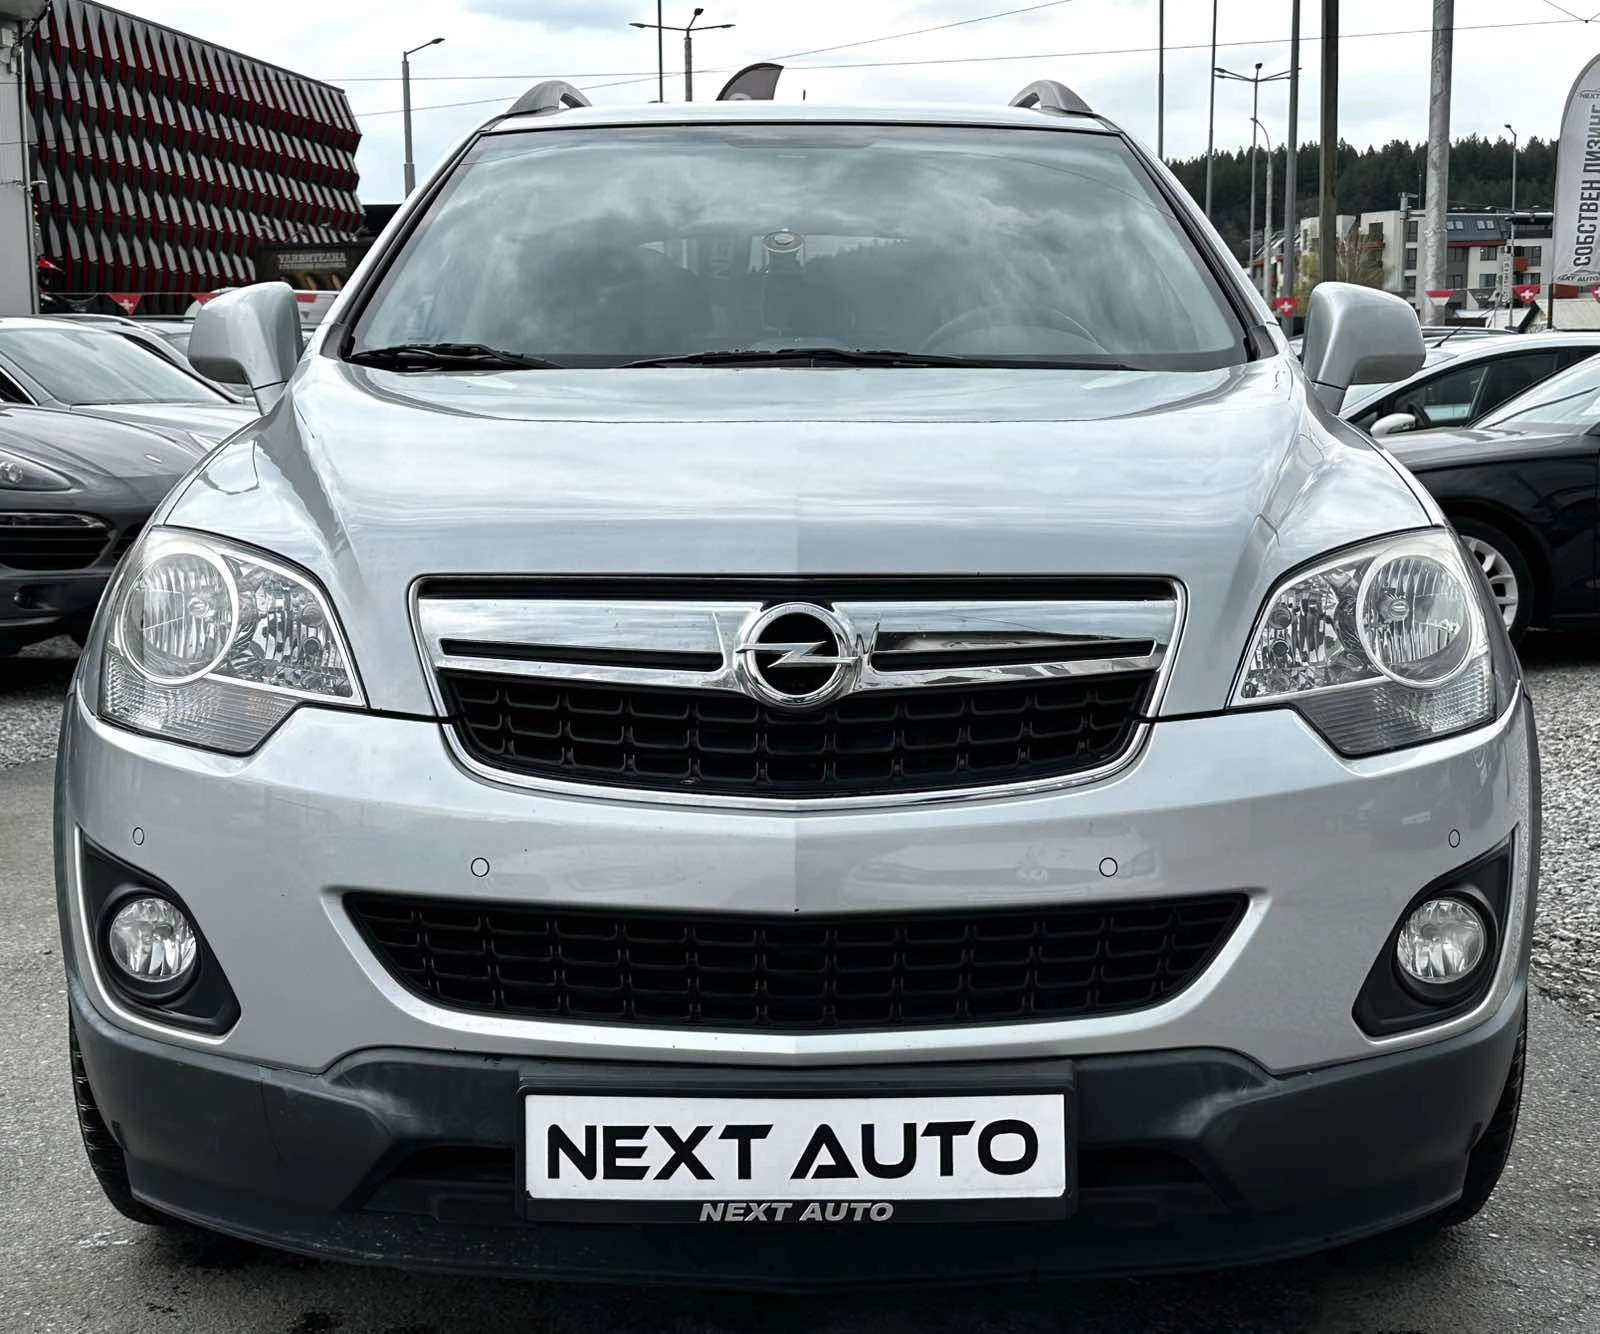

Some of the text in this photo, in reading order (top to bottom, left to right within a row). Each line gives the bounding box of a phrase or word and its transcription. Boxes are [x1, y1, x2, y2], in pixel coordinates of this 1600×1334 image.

[1573, 180, 1600, 267] СОБСТВЕН
[548, 1120, 1038, 1180] NEXT AUTO
[700, 1203, 893, 1221] NEXT AUTO
